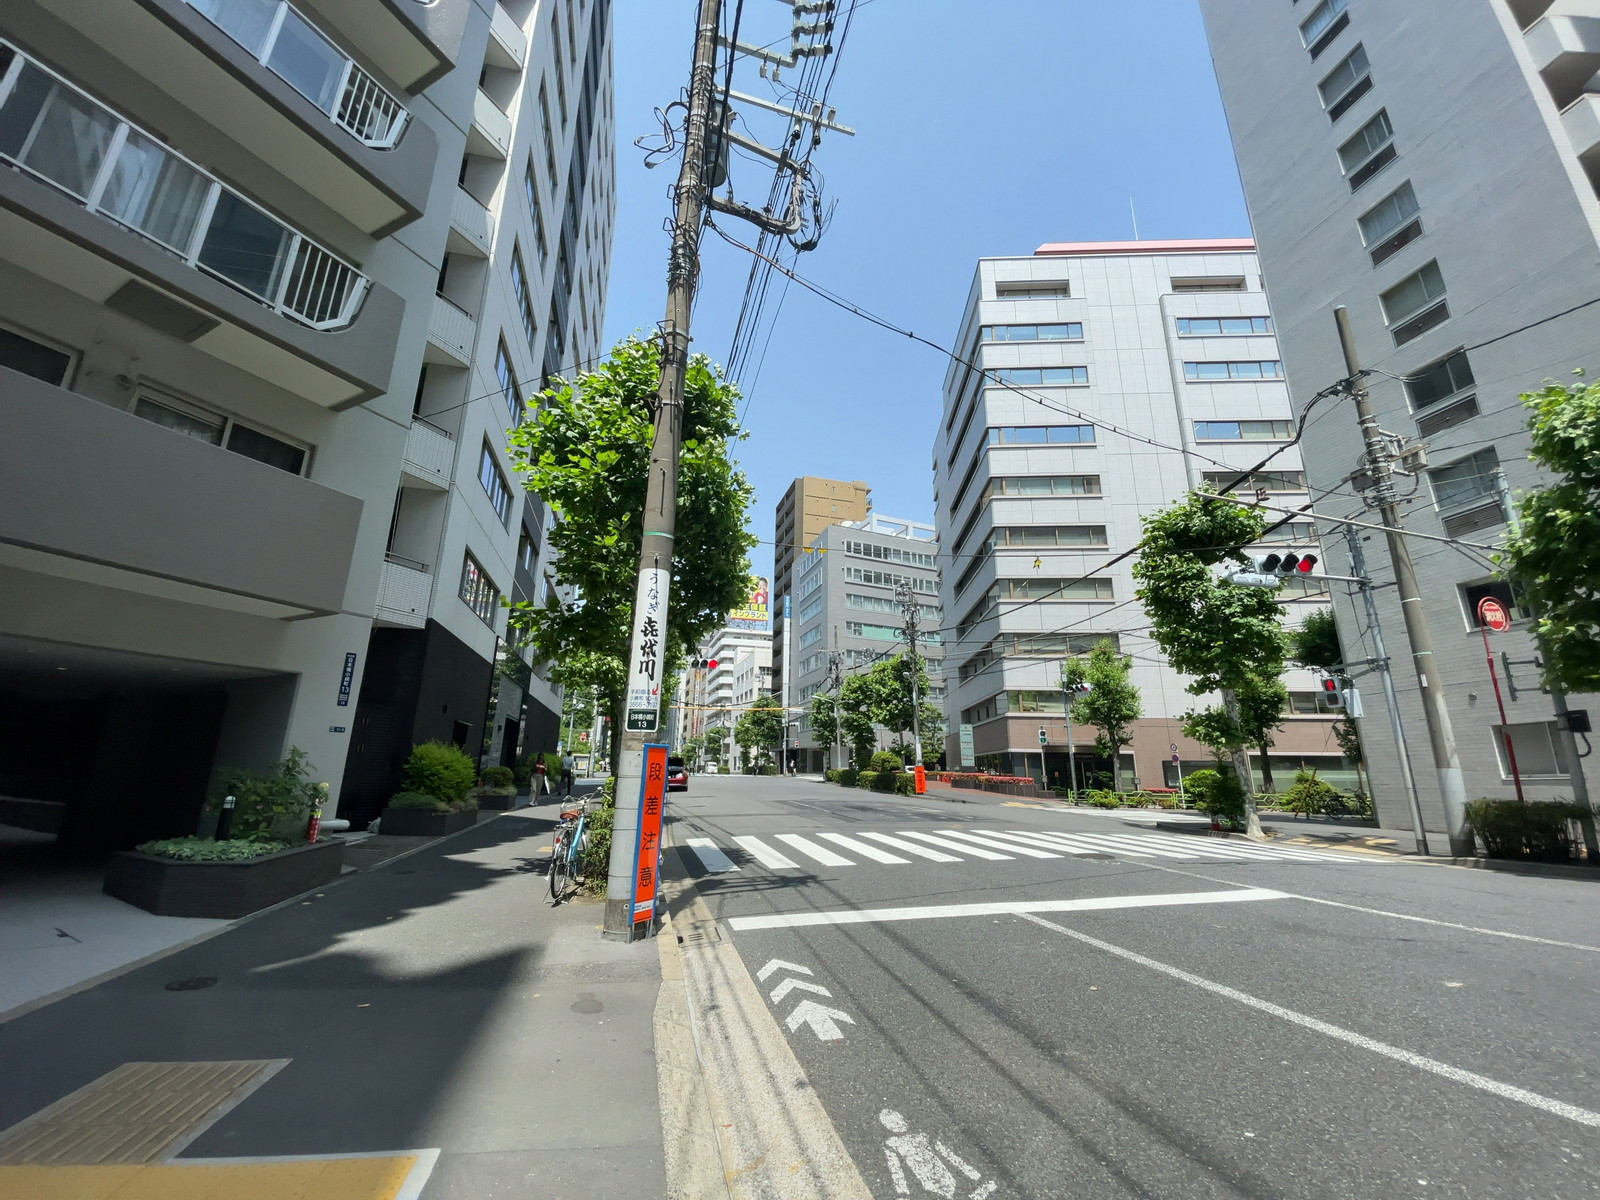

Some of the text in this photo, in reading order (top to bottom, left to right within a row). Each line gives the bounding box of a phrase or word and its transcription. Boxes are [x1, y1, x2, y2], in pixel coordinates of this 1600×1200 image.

[647, 572, 660, 614] うなぎ
[733, 610, 767, 619] インプラント
[630, 713, 655, 721] 日本橋小網町
[639, 762, 662, 887] 段差注意
